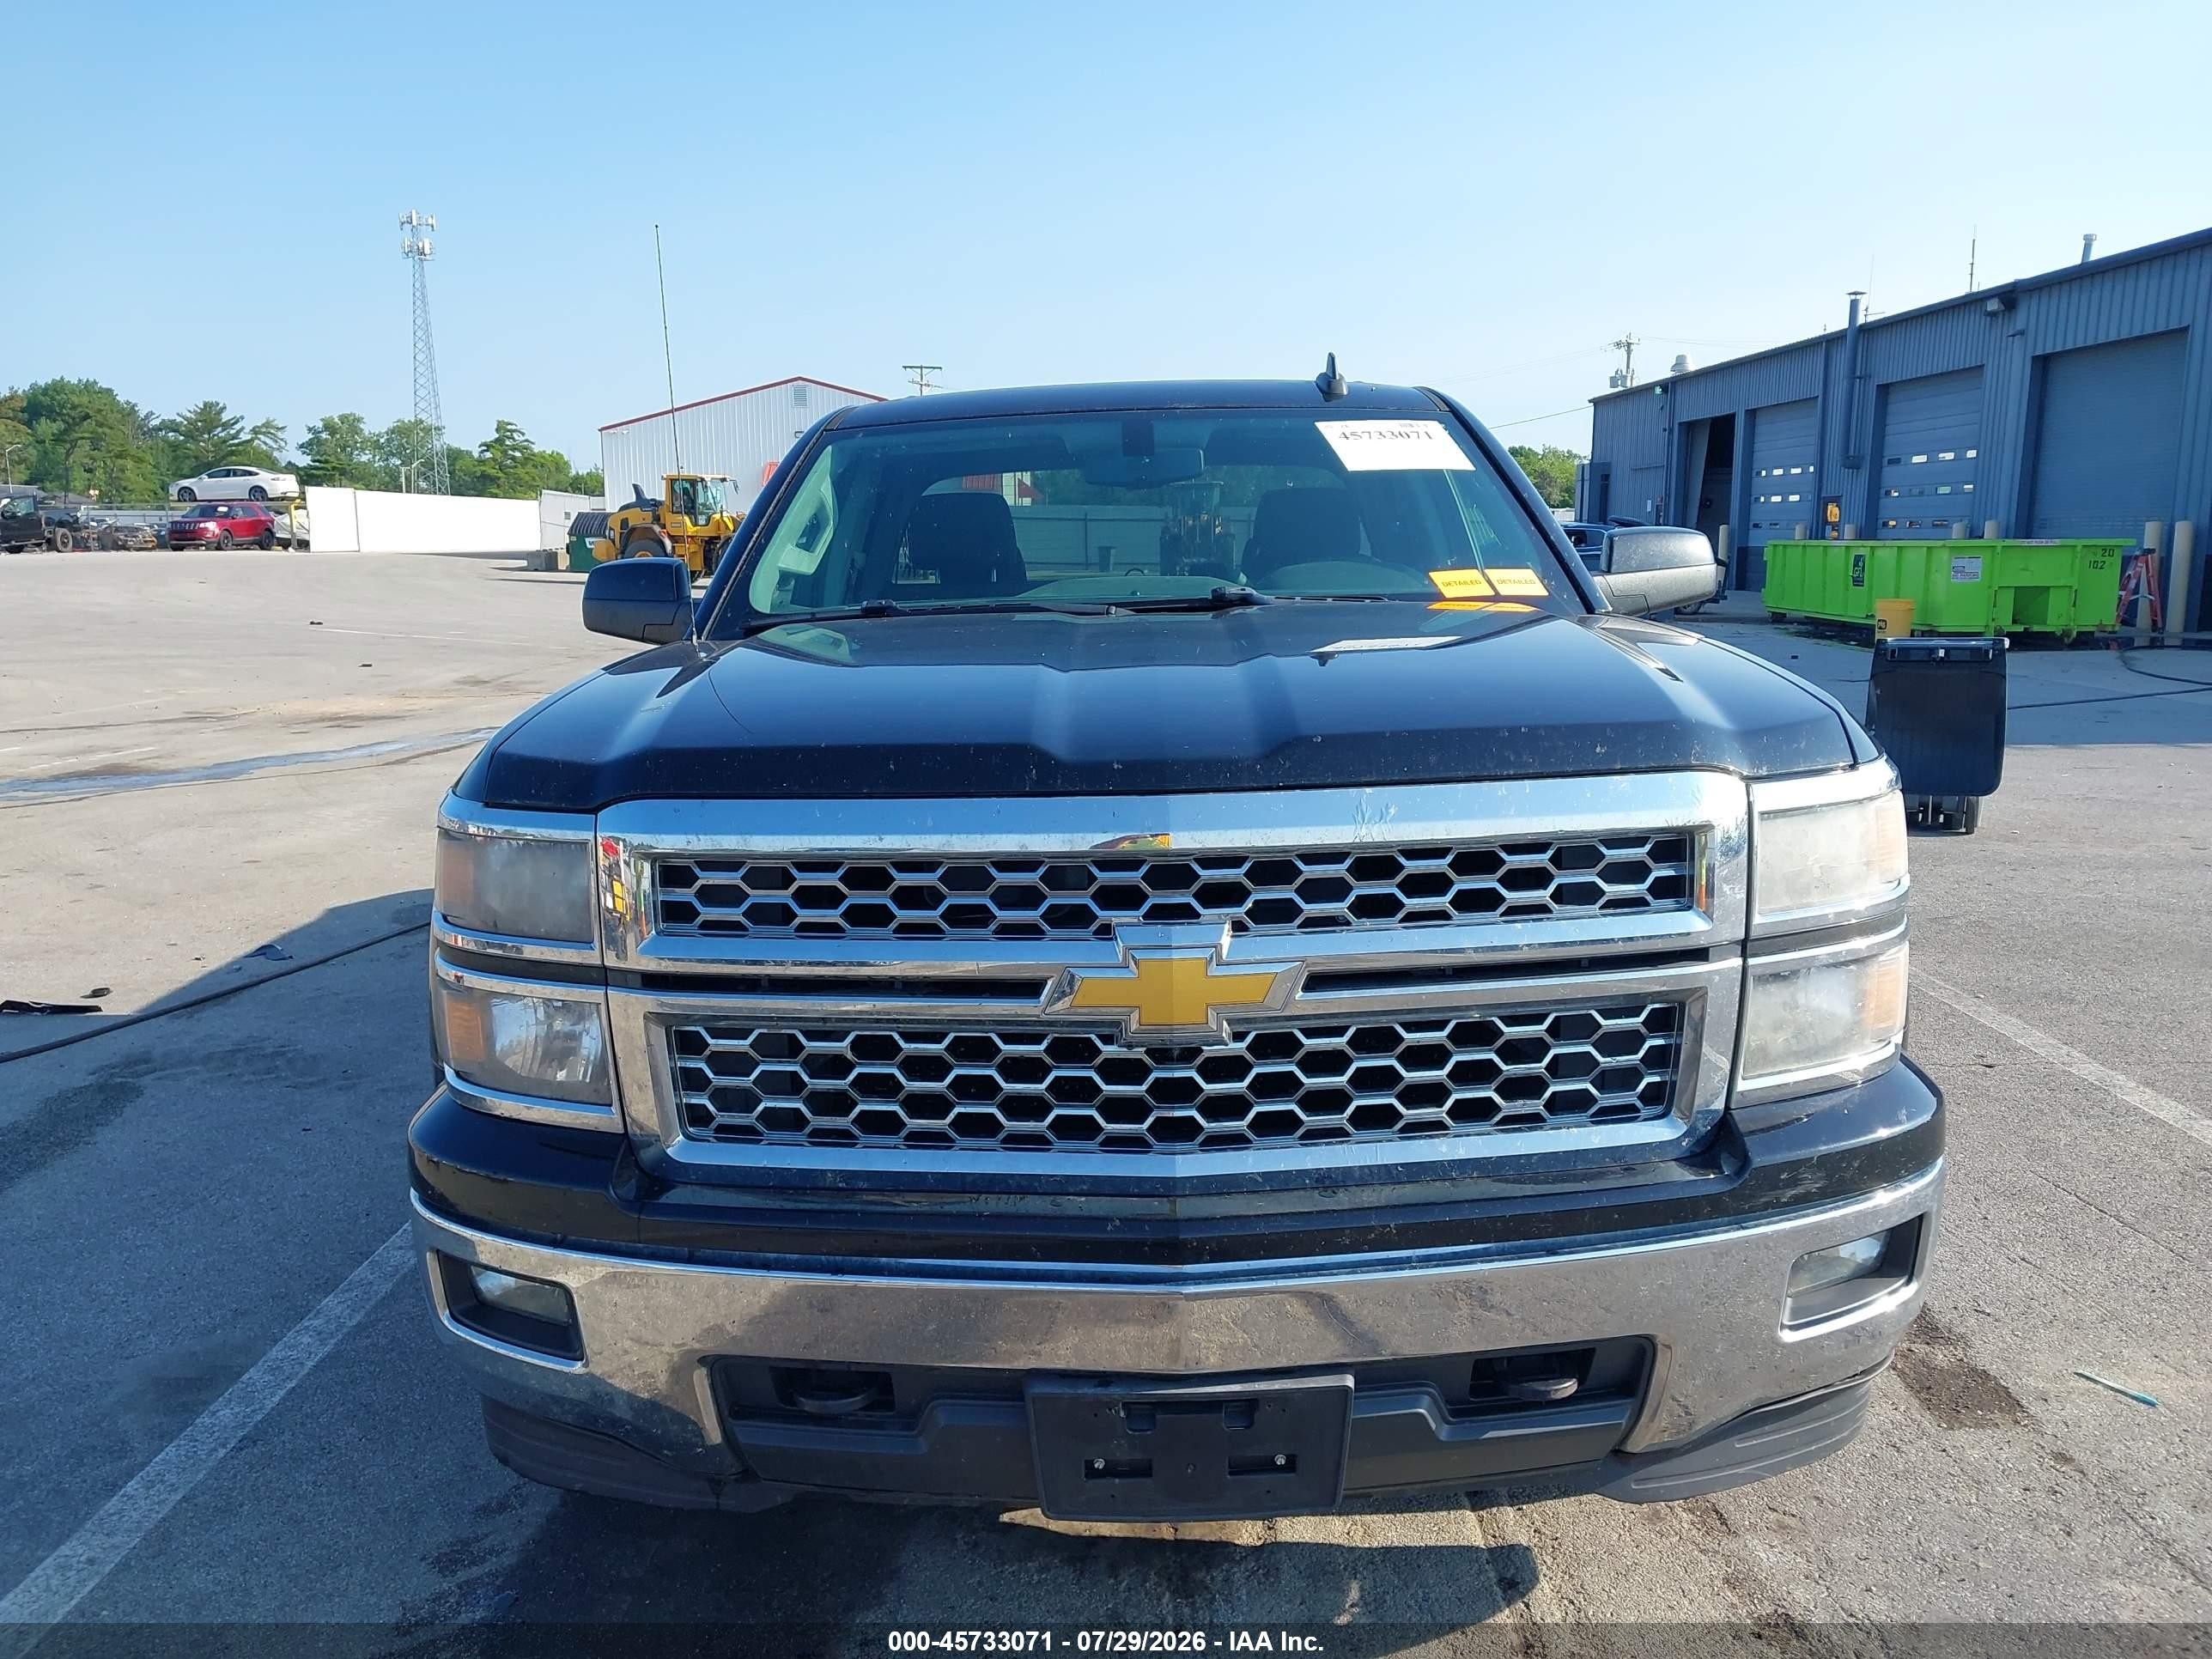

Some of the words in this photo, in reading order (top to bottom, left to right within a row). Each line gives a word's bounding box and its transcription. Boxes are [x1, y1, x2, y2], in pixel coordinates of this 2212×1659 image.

[1339, 430, 1433, 441] 45733071
[2100, 548, 2115, 557] 20
[2088, 560, 2106, 570] 102
[1442, 579, 1481, 587] DETAILED
